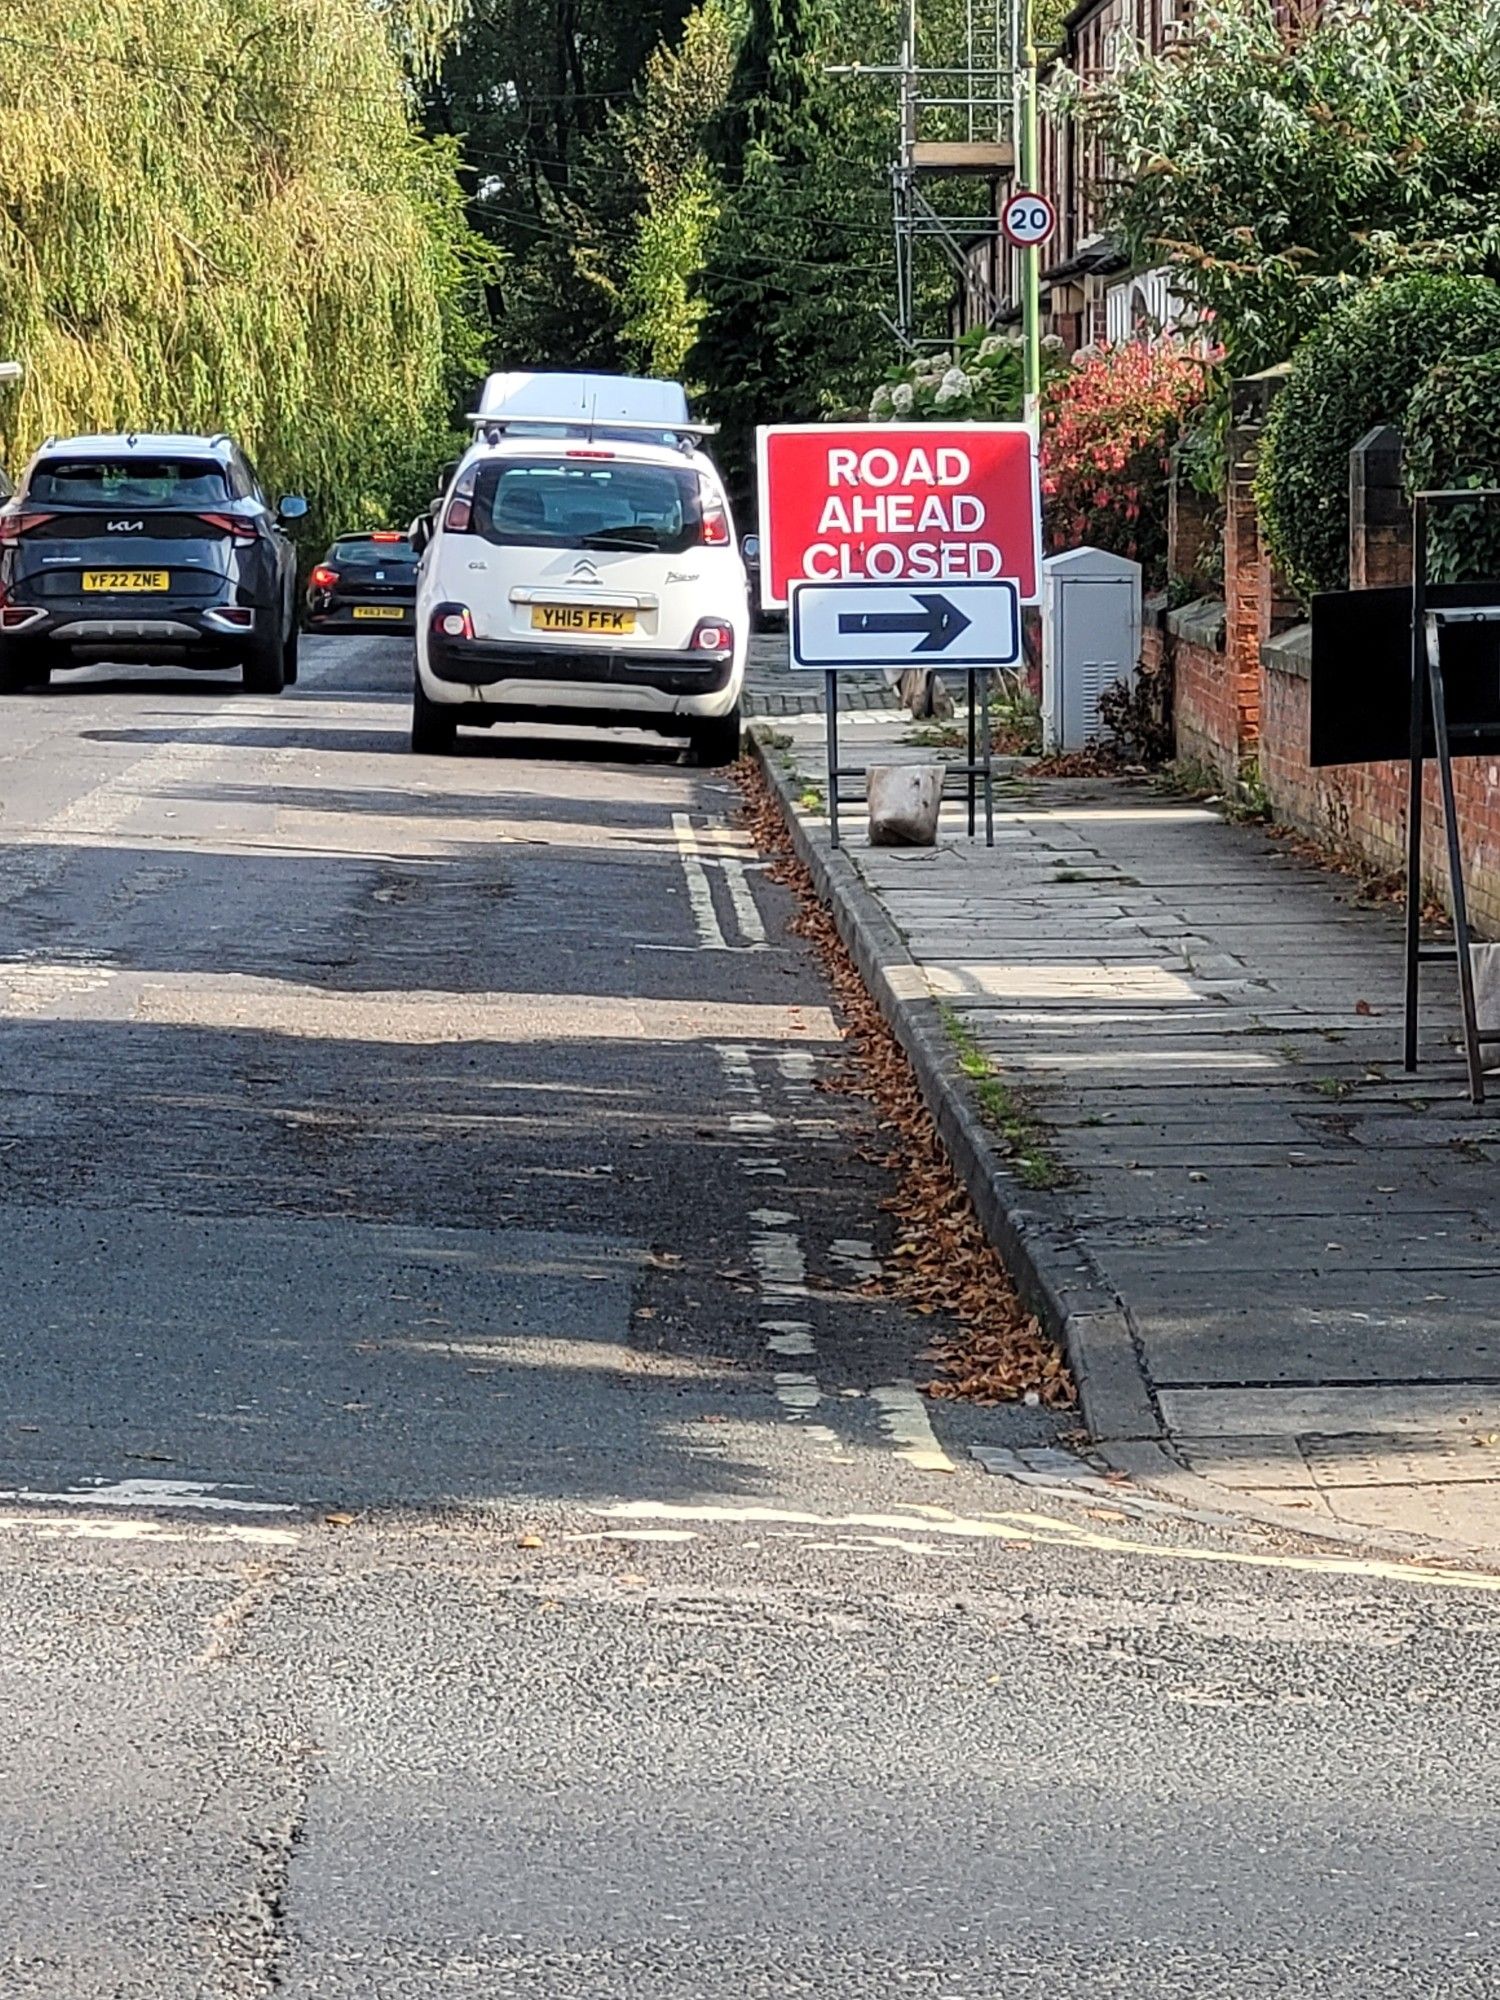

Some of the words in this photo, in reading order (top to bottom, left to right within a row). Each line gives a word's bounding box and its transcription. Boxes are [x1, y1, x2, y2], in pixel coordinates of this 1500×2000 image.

[1011, 208, 1047, 229] 20
[827, 448, 970, 487] ROAD
[817, 495, 986, 534] AHEAD
[802, 542, 1002, 579] CLOSED
[89, 573, 129, 587] YF22
[132, 573, 162, 587] ZNE
[543, 608, 583, 627] YH15
[588, 611, 624, 629] FFK
